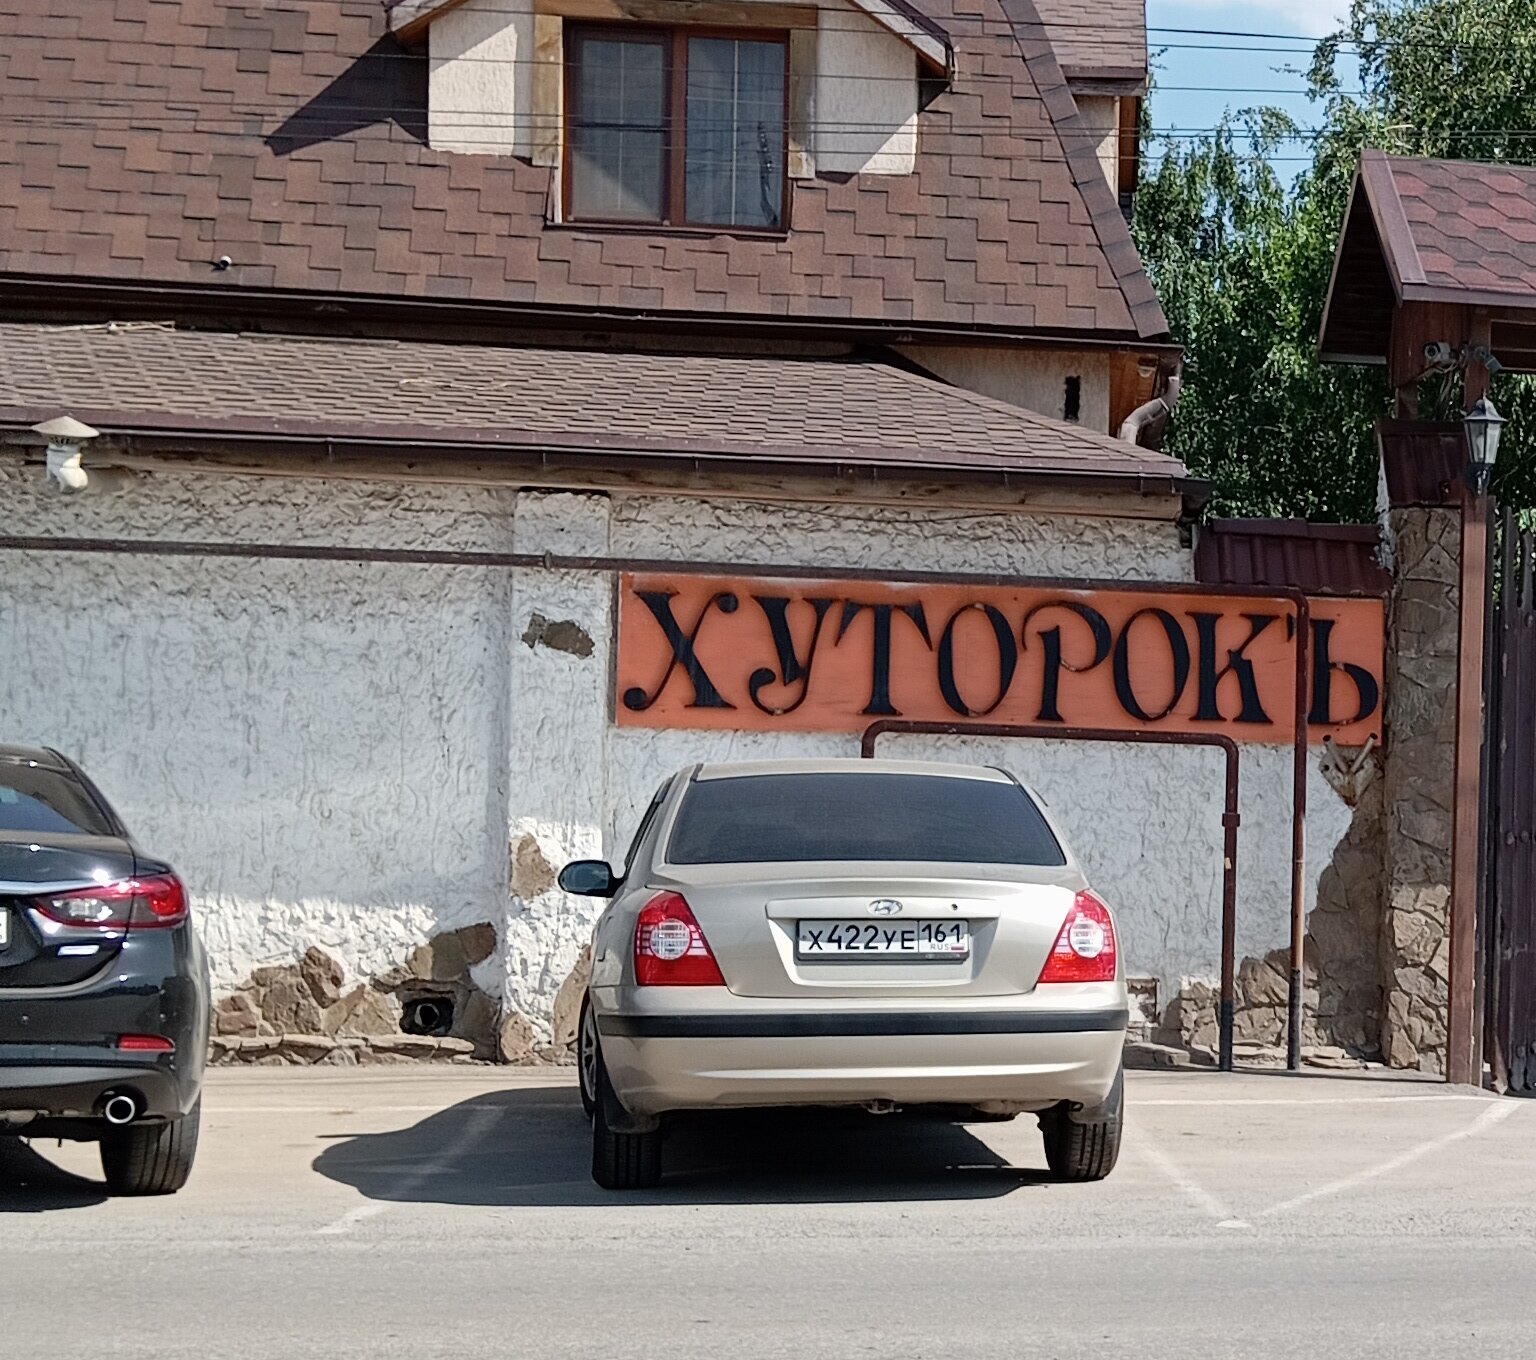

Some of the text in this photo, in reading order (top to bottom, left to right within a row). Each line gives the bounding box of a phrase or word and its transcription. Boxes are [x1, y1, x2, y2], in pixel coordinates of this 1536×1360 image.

[622, 590, 1379, 726] ХУТОРОКЪ
[921, 923, 961, 943] 161
[930, 943, 949, 951] RUS
